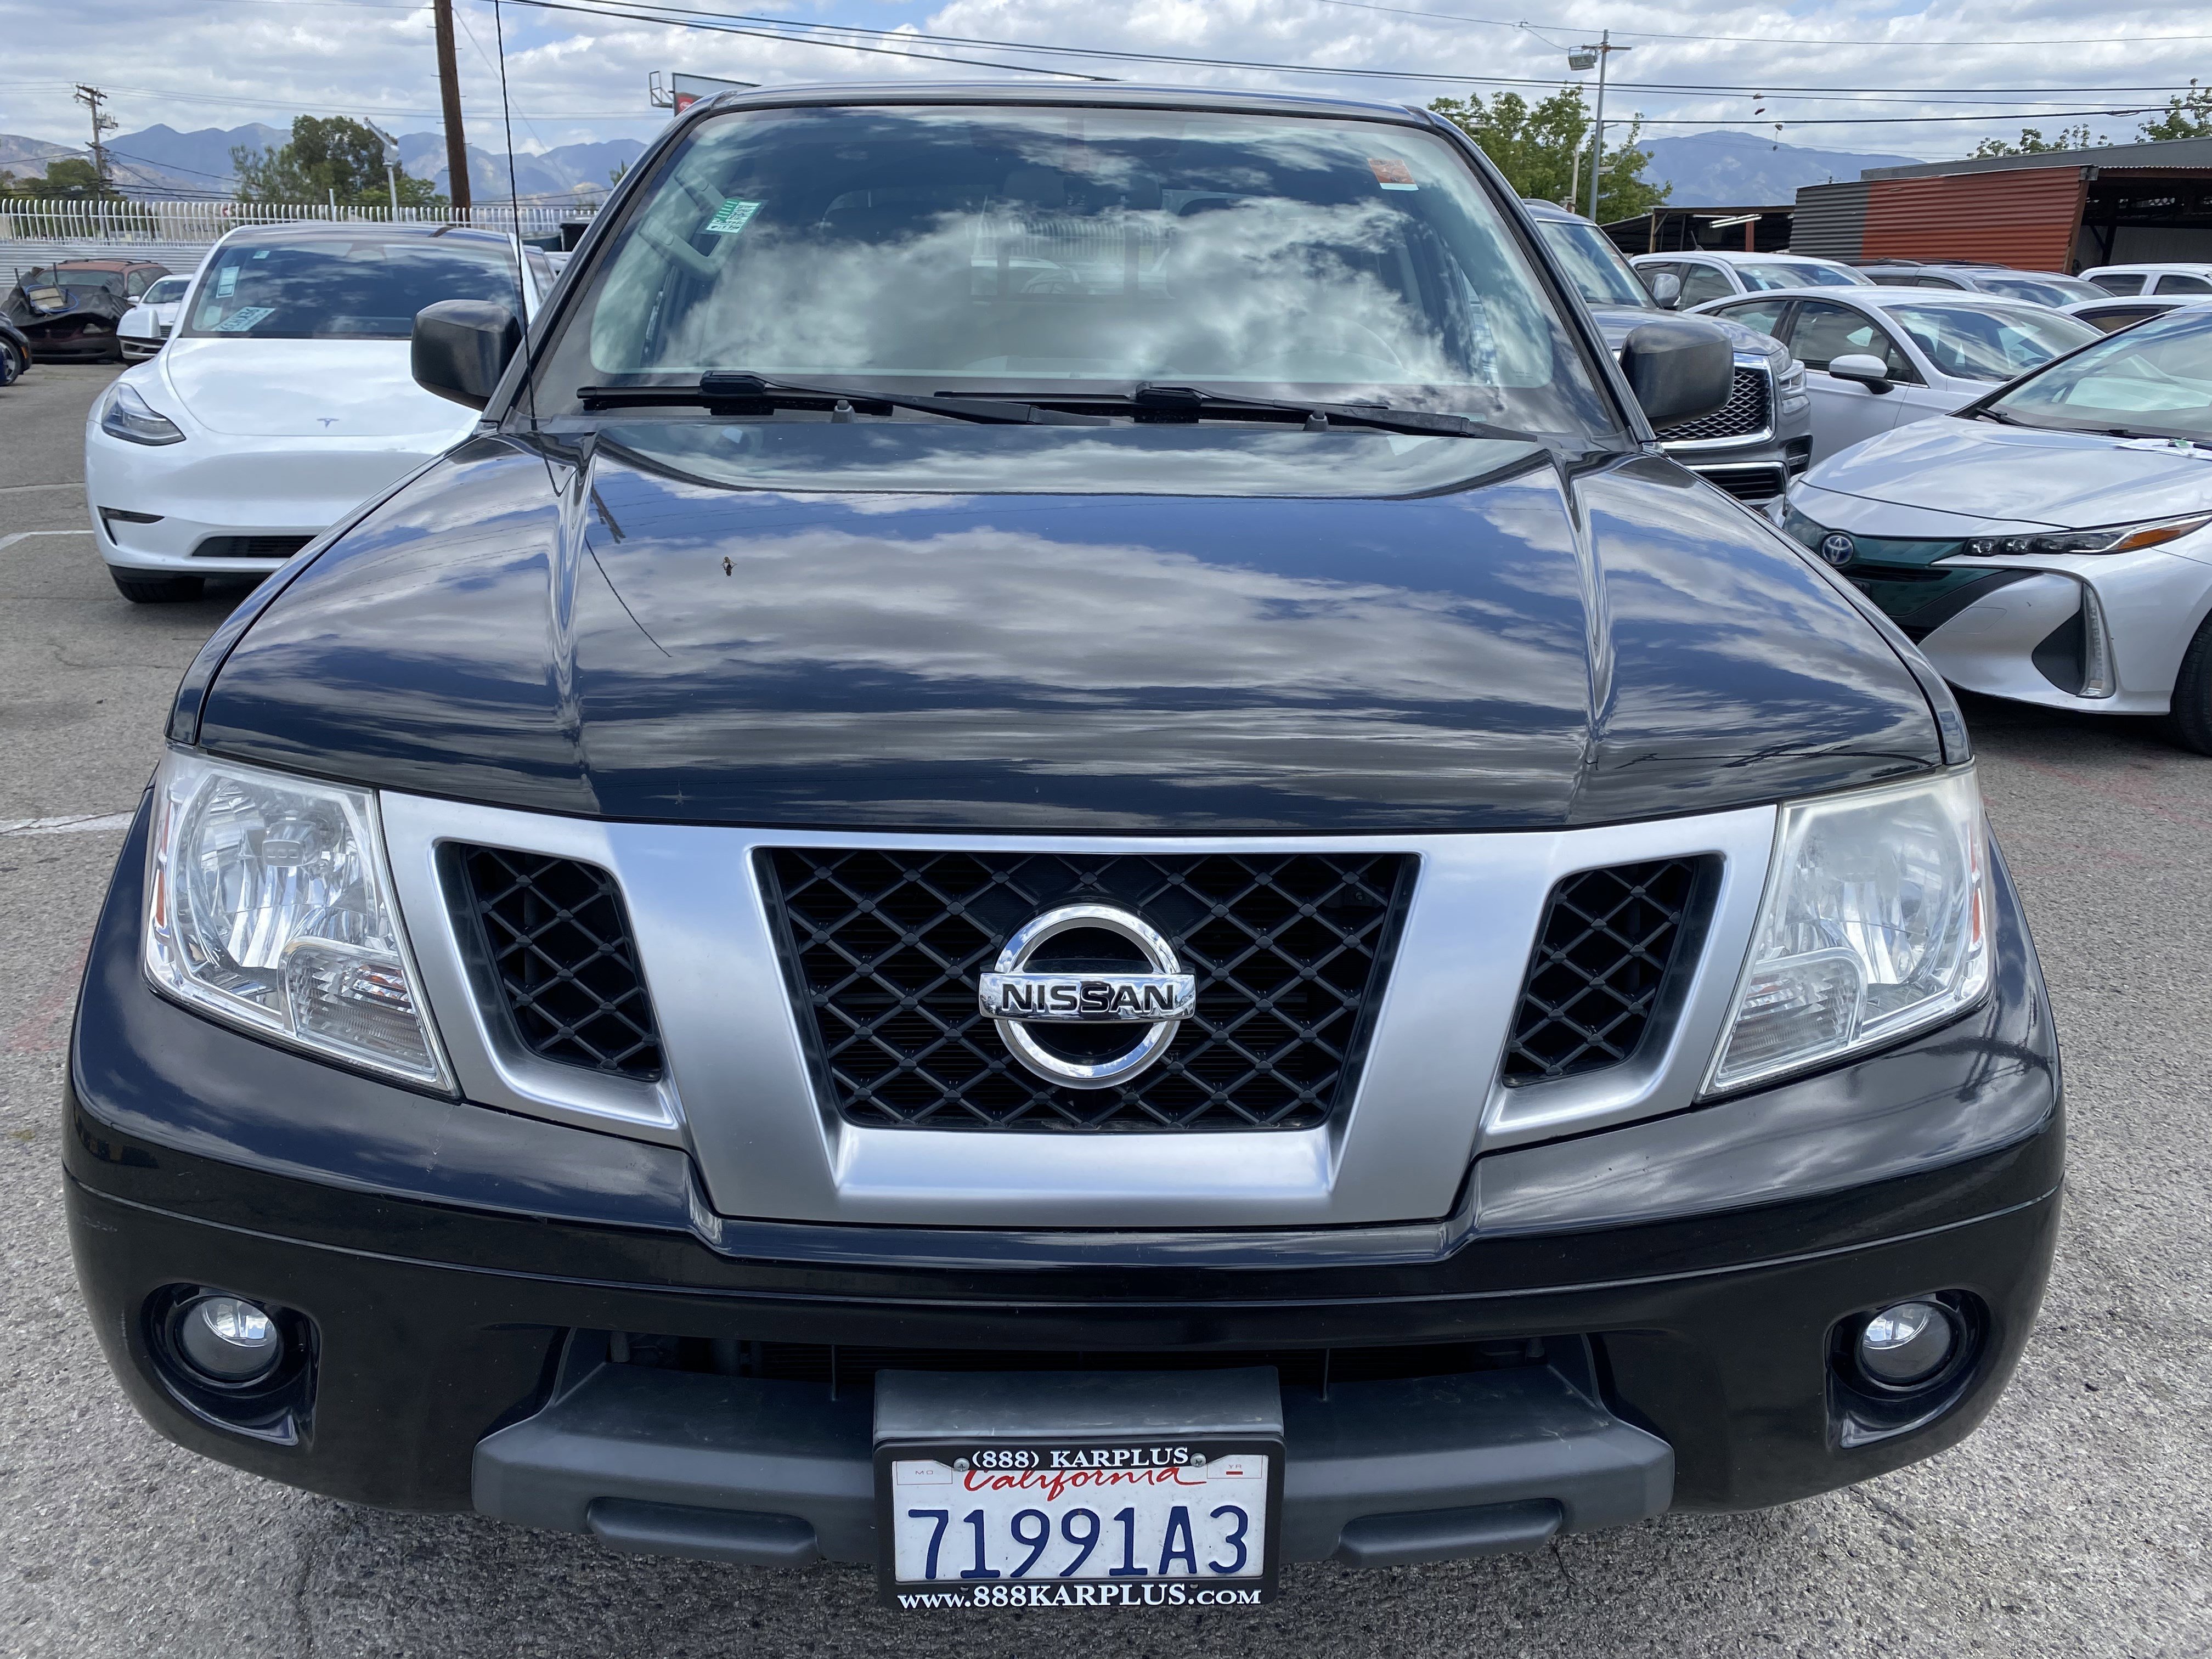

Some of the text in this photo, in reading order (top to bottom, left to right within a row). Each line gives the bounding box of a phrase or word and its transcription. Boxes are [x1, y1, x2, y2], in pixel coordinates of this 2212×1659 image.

[1002, 983, 1174, 1013] NISSAN
[972, 1447, 1189, 1469] (888) KARPLUS
[964, 1466, 1207, 1502] California
[908, 1505, 1249, 1579] 71991A3
